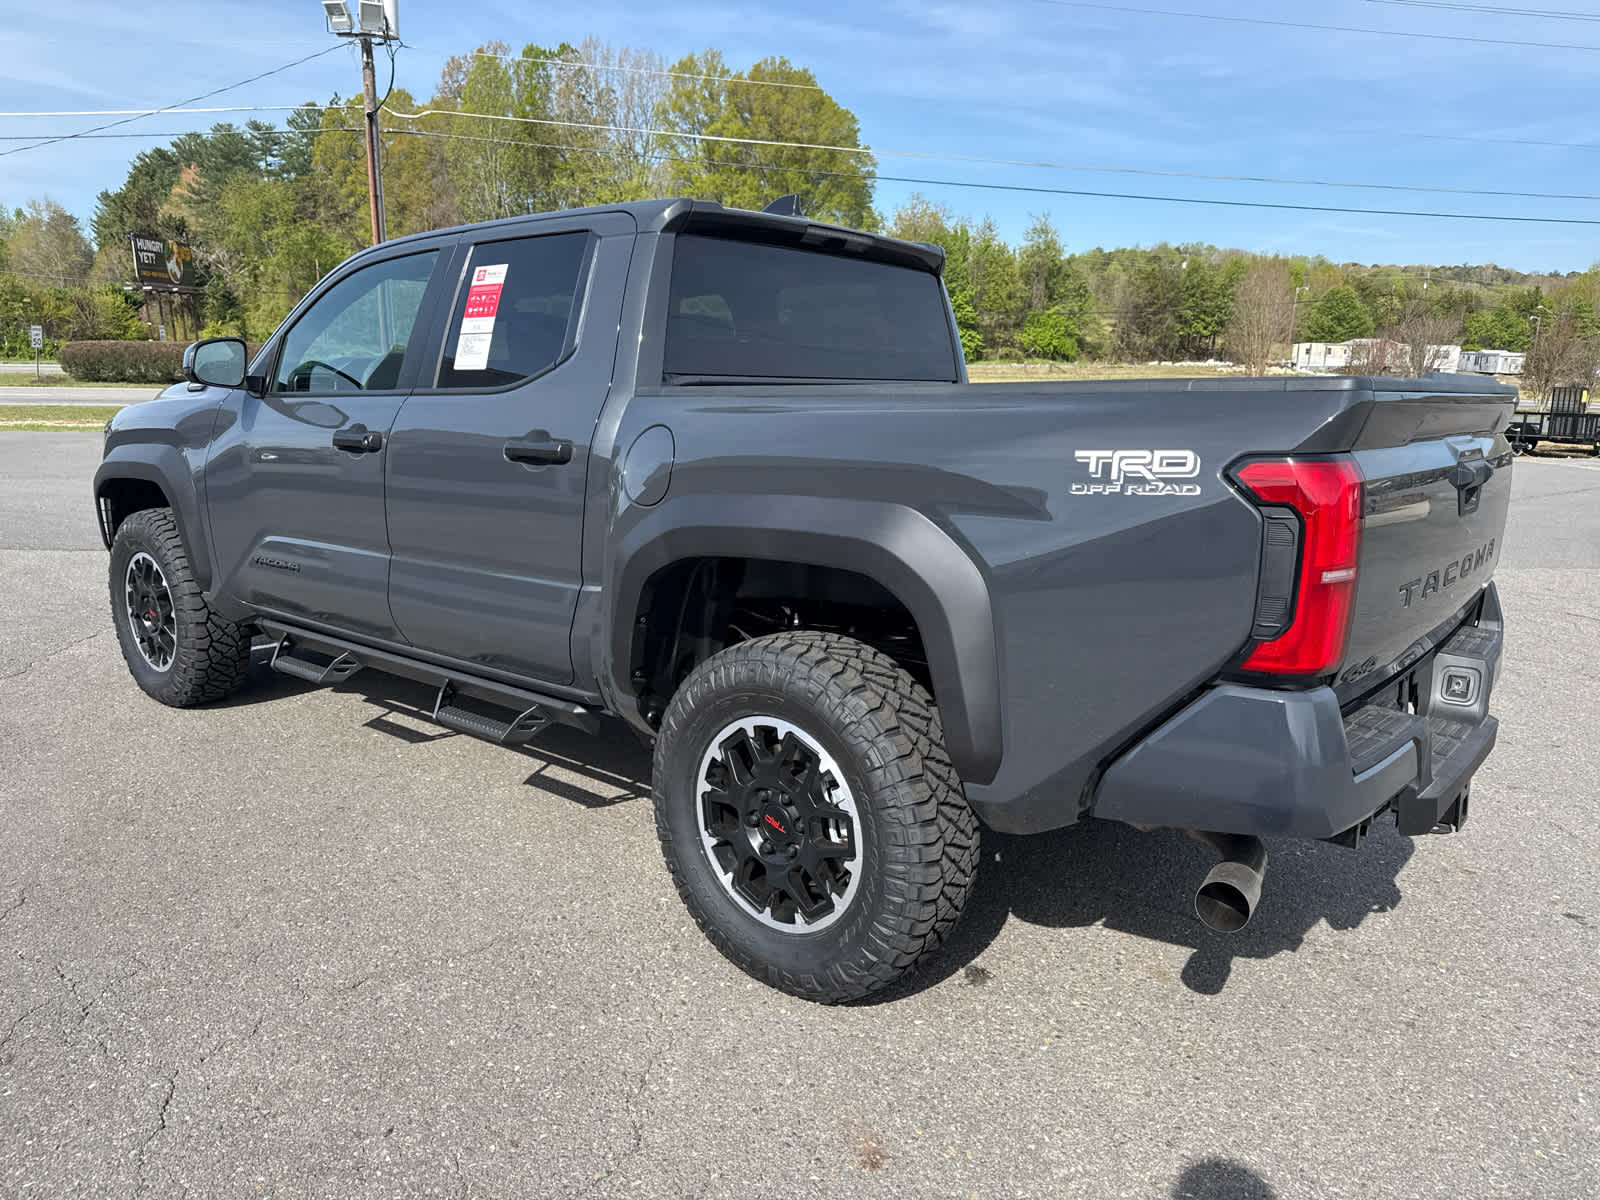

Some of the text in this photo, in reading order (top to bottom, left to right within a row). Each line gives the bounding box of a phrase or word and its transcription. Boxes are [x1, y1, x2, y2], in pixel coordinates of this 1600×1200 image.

[136, 238, 164, 253] HUNGRY
[138, 251, 156, 264] YET?
[1074, 450, 1201, 484] TRD
[1069, 481, 1202, 496] OFF ROAD
[1399, 538, 1495, 608] TACOMA
